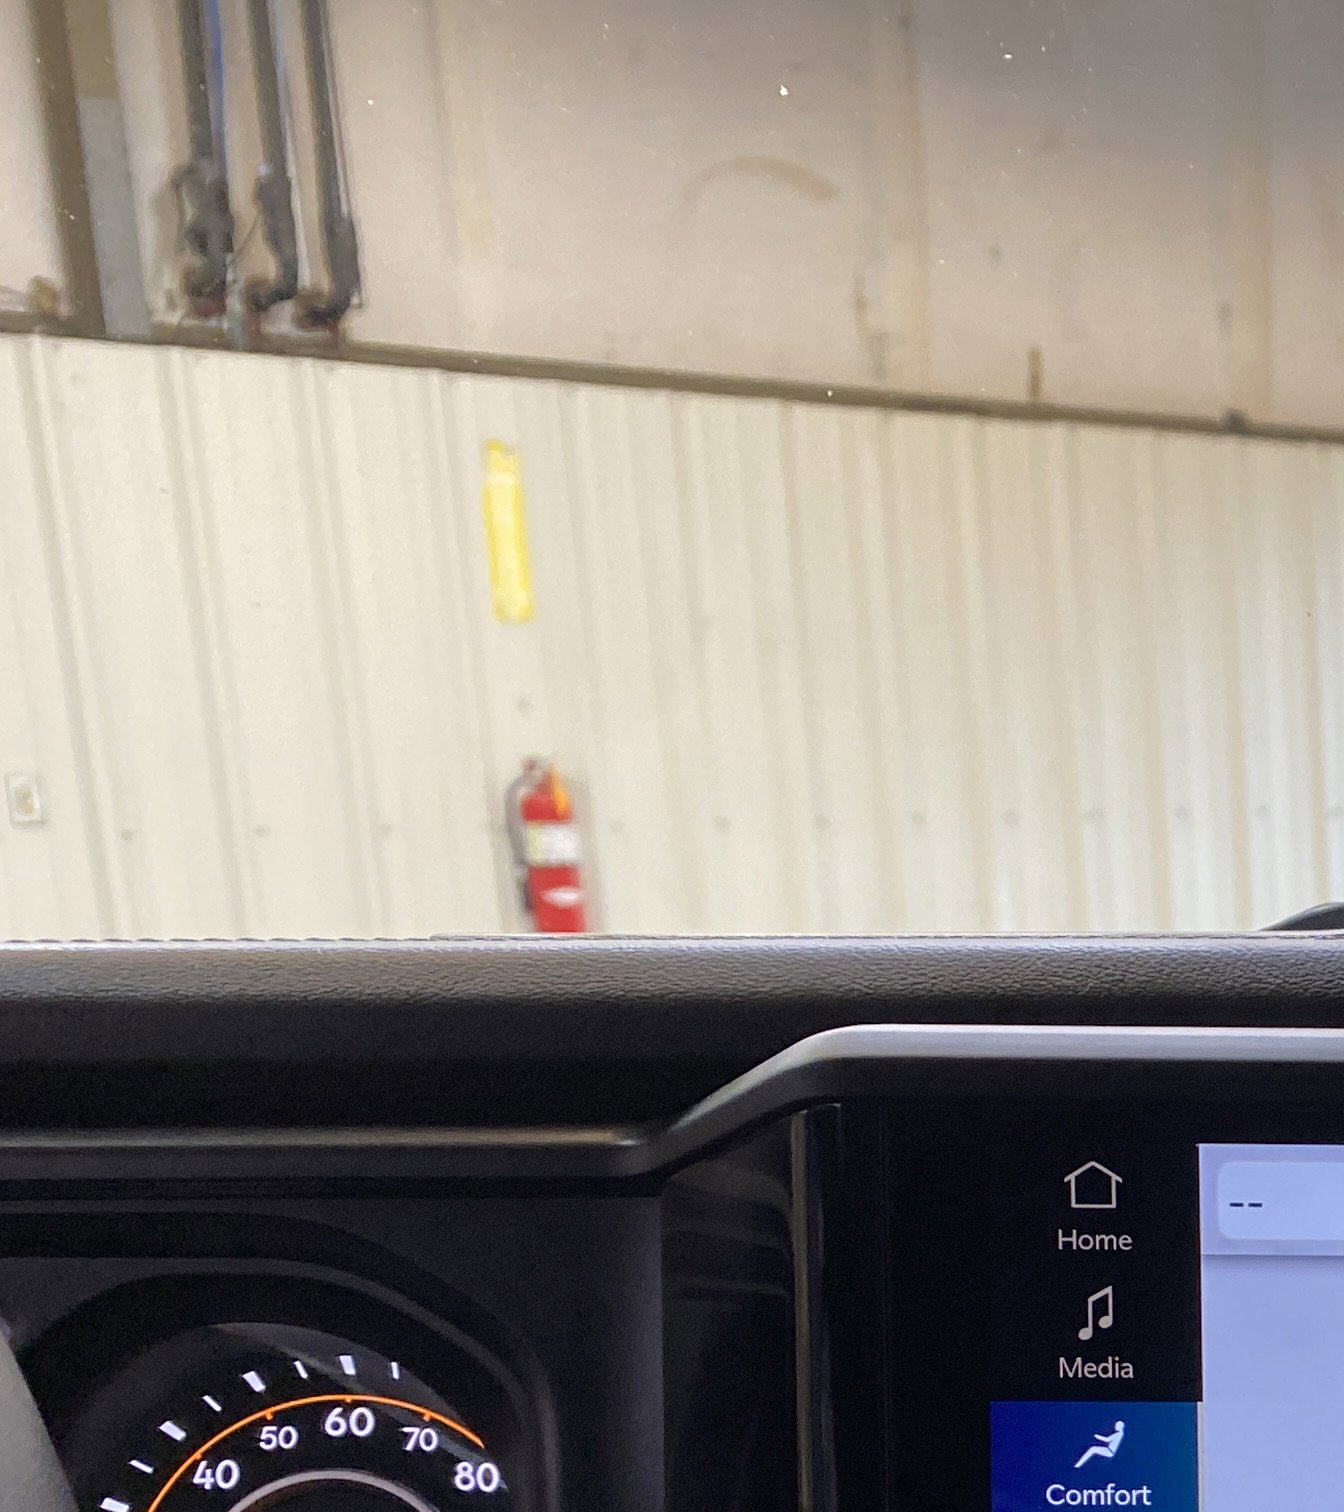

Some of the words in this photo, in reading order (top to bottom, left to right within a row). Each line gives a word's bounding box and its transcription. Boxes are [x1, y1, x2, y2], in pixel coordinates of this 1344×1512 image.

[1057, 1230, 1133, 1252] Home
[1058, 1357, 1134, 1380] Media
[325, 1408, 375, 1437] 60
[259, 1426, 298, 1450] 50
[401, 1426, 439, 1452] 70
[192, 1459, 240, 1490] 40
[453, 1461, 500, 1493] 80
[1045, 1483, 1151, 1507] Comfort
